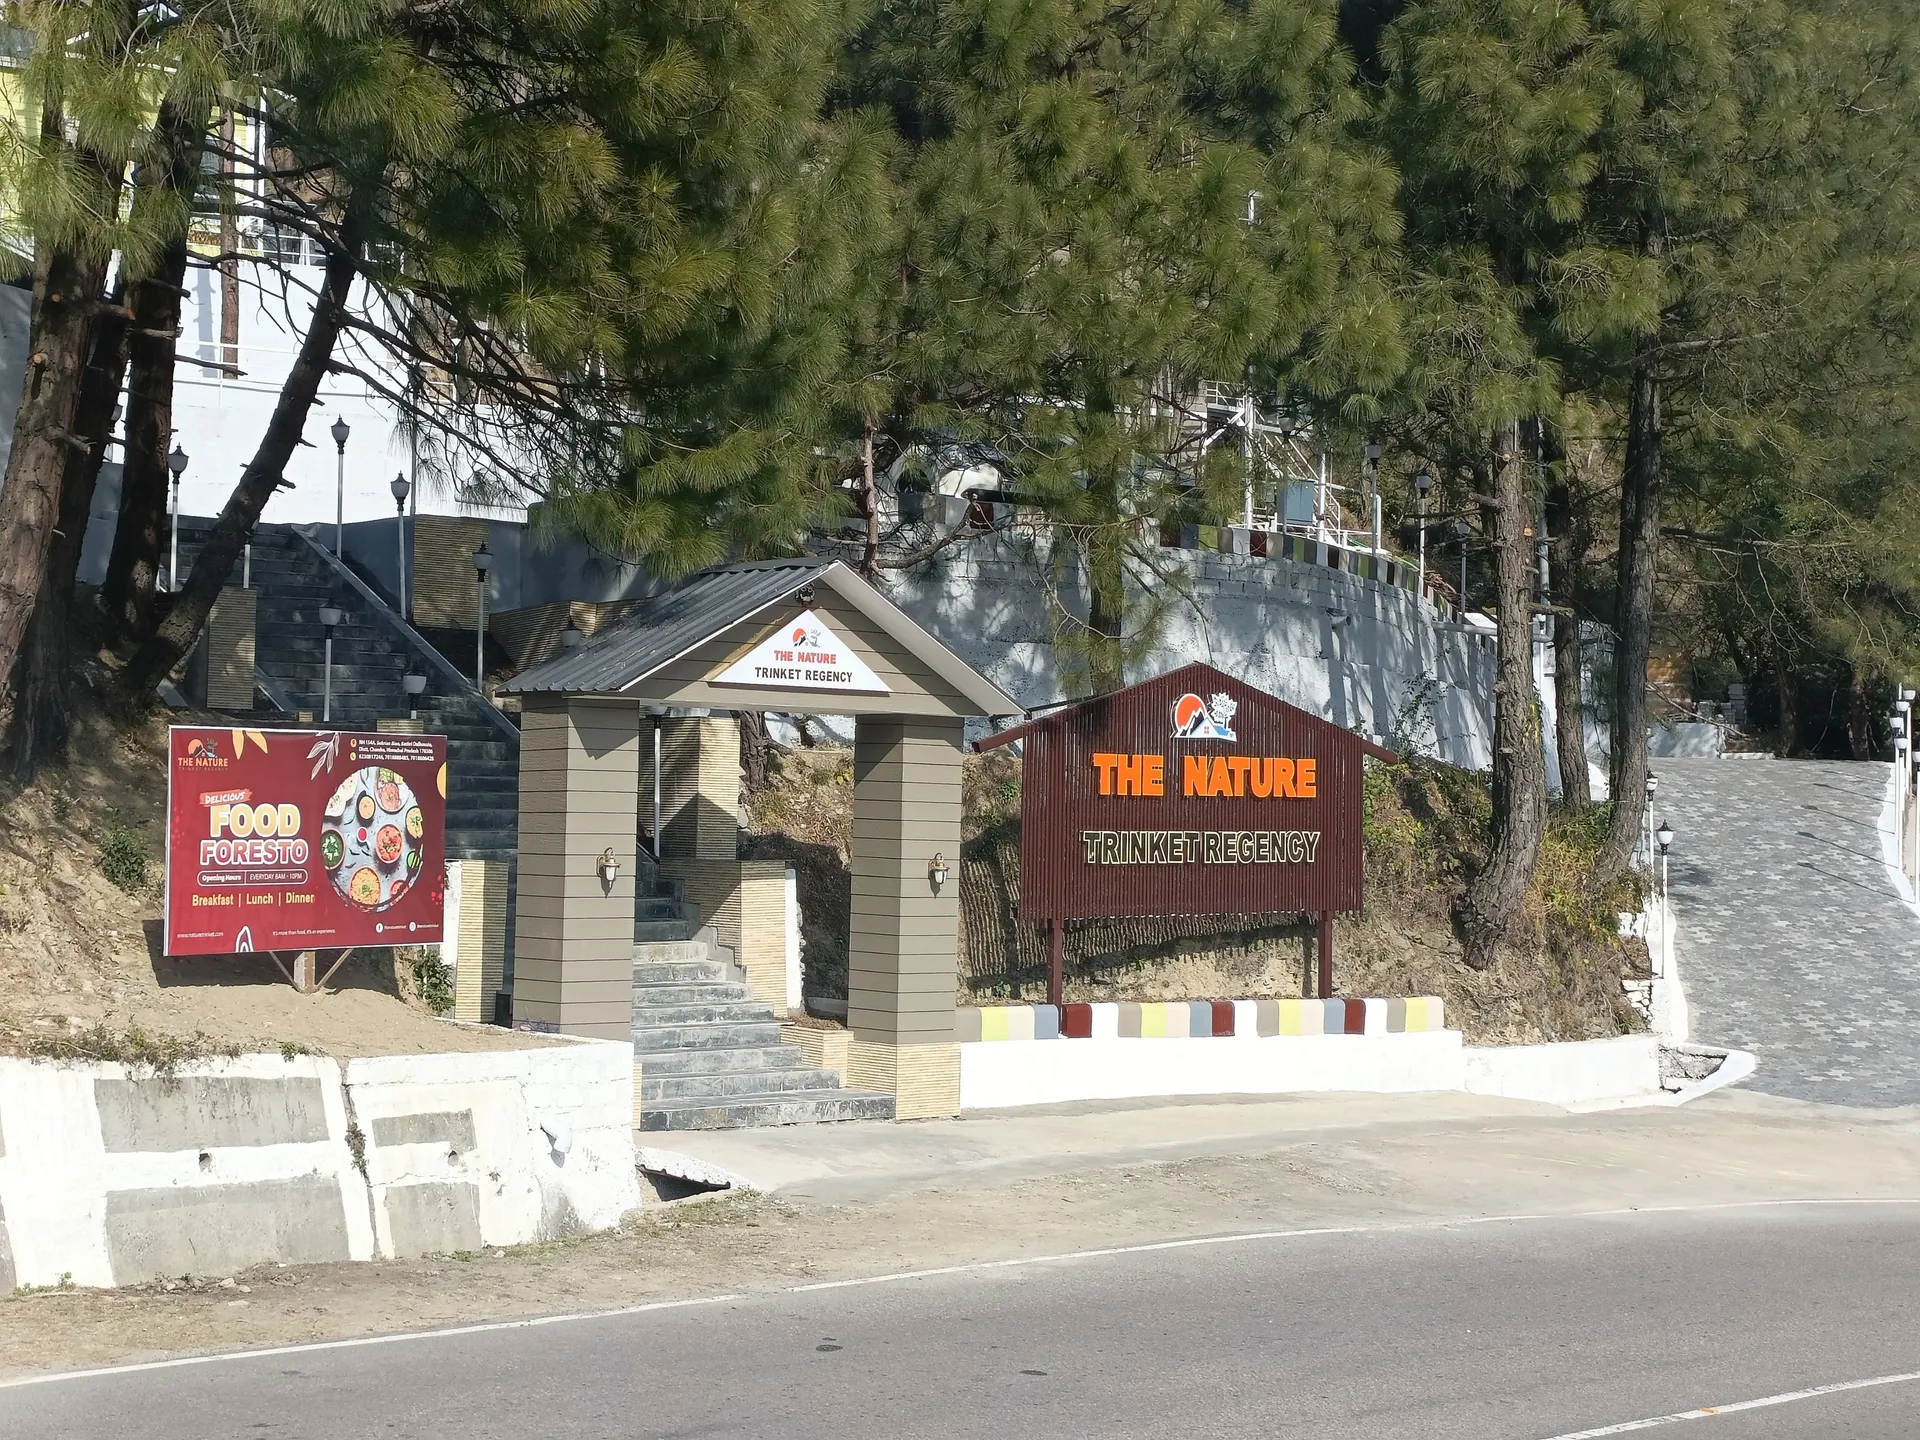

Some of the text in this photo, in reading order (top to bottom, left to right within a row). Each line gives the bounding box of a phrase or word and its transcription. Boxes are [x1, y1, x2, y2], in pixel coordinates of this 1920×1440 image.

[774, 650, 837, 665] THE NATURE
[755, 667, 853, 683] TRINKET REGENCY
[178, 757, 228, 767] THE NATURE
[1093, 753, 1317, 798] THE NATURE
[205, 791, 246, 804] DELICIOUS
[210, 803, 301, 838] FOOD
[200, 839, 309, 866] FORESTO
[1083, 830, 1321, 864] TRINKET REGENCY
[202, 874, 225, 882] Opening
[192, 894, 234, 906] Breakfast
[246, 893, 274, 905] Lunch
[286, 892, 315, 904] Dinner
